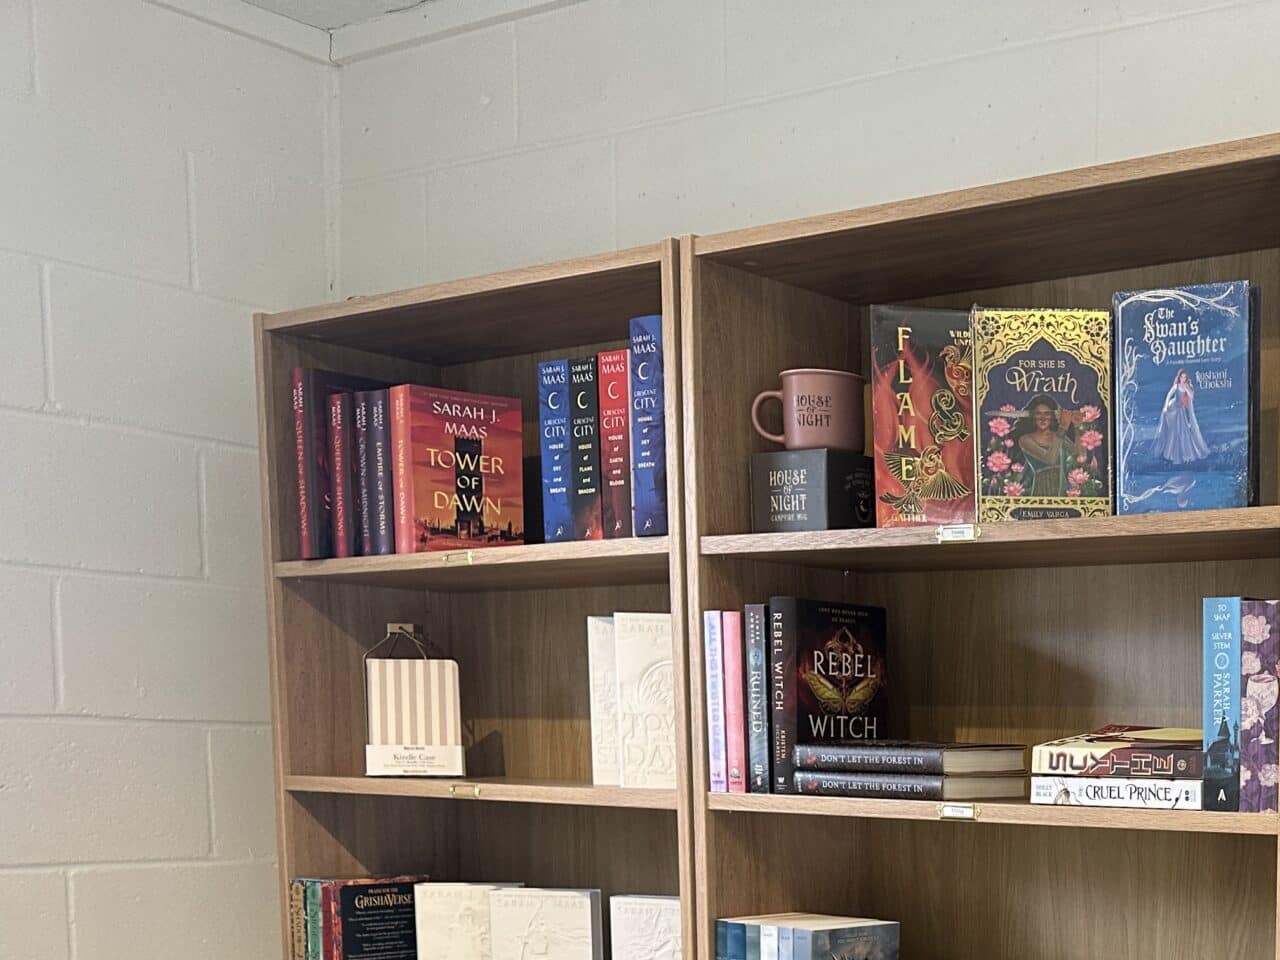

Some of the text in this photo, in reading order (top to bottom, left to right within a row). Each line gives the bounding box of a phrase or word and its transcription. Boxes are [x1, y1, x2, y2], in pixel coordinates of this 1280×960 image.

[1158, 308, 1174, 319] The
[1144, 310, 1200, 344] Swan's
[1151, 336, 1226, 366] Daughter
[1019, 360, 1066, 369] FOR SHE IS
[1006, 366, 1079, 403] Wrath
[1196, 369, 1228, 382] Roshani
[1200, 378, 1232, 389] Chokshi
[433, 401, 500, 424] SARAH J.
[896, 326, 916, 481] FLAME
[444, 423, 487, 439] MAAS
[544, 425, 567, 439] CITY
[426, 448, 504, 475] TOWER
[457, 476, 480, 489] OF
[769, 469, 807, 486] HOUSE
[434, 492, 501, 515] DAWN
[770, 494, 806, 512] NIGHT
[1022, 510, 1069, 518] EMILY VARGA
[1217, 604, 1227, 612] TO
[1213, 614, 1230, 622] SNAP
[1211, 632, 1232, 640] SILVER
[1213, 642, 1230, 650] STEM
[773, 613, 784, 711] REBEL WITCH
[814, 650, 876, 678] REBEL
[750, 670, 762, 733] RUINED
[1213, 673, 1222, 725] PARKER
[808, 714, 877, 739] WITCH
[821, 754, 923, 765] DON'T LET THE FOREST IN
[1048, 752, 1173, 775] SCYTHE
[1086, 783, 1172, 805] CRUEL PRINCE
